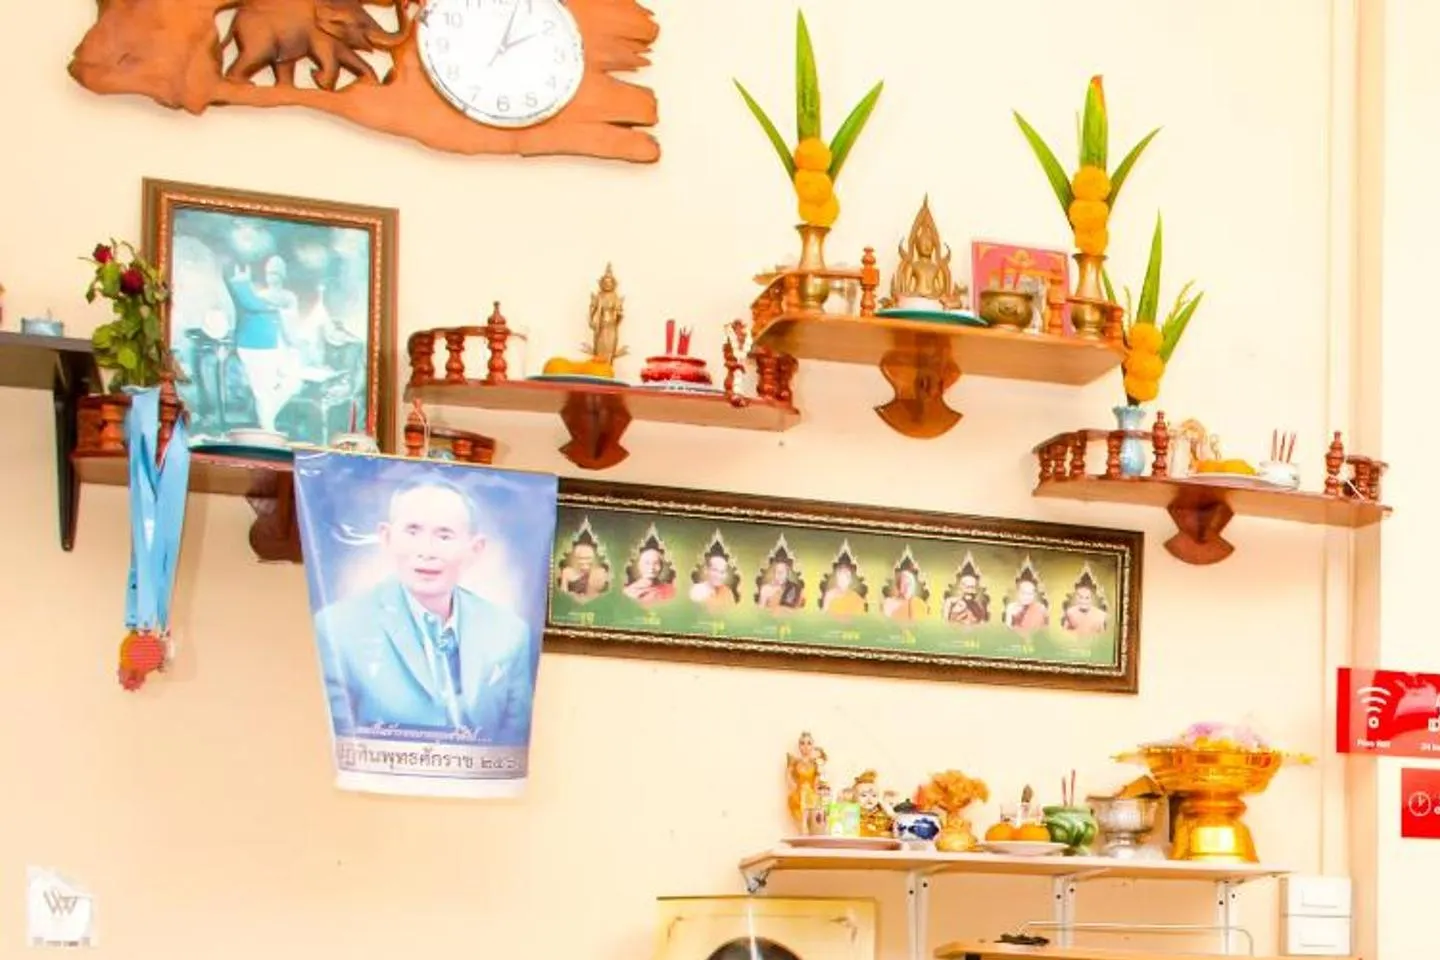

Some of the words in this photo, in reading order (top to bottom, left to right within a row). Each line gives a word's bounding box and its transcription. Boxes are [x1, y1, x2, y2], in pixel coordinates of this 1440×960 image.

[442, 11, 464, 29] 10
[540, 19, 556, 37] 2
[496, 94, 511, 113] 6
[525, 91, 539, 108] 5
